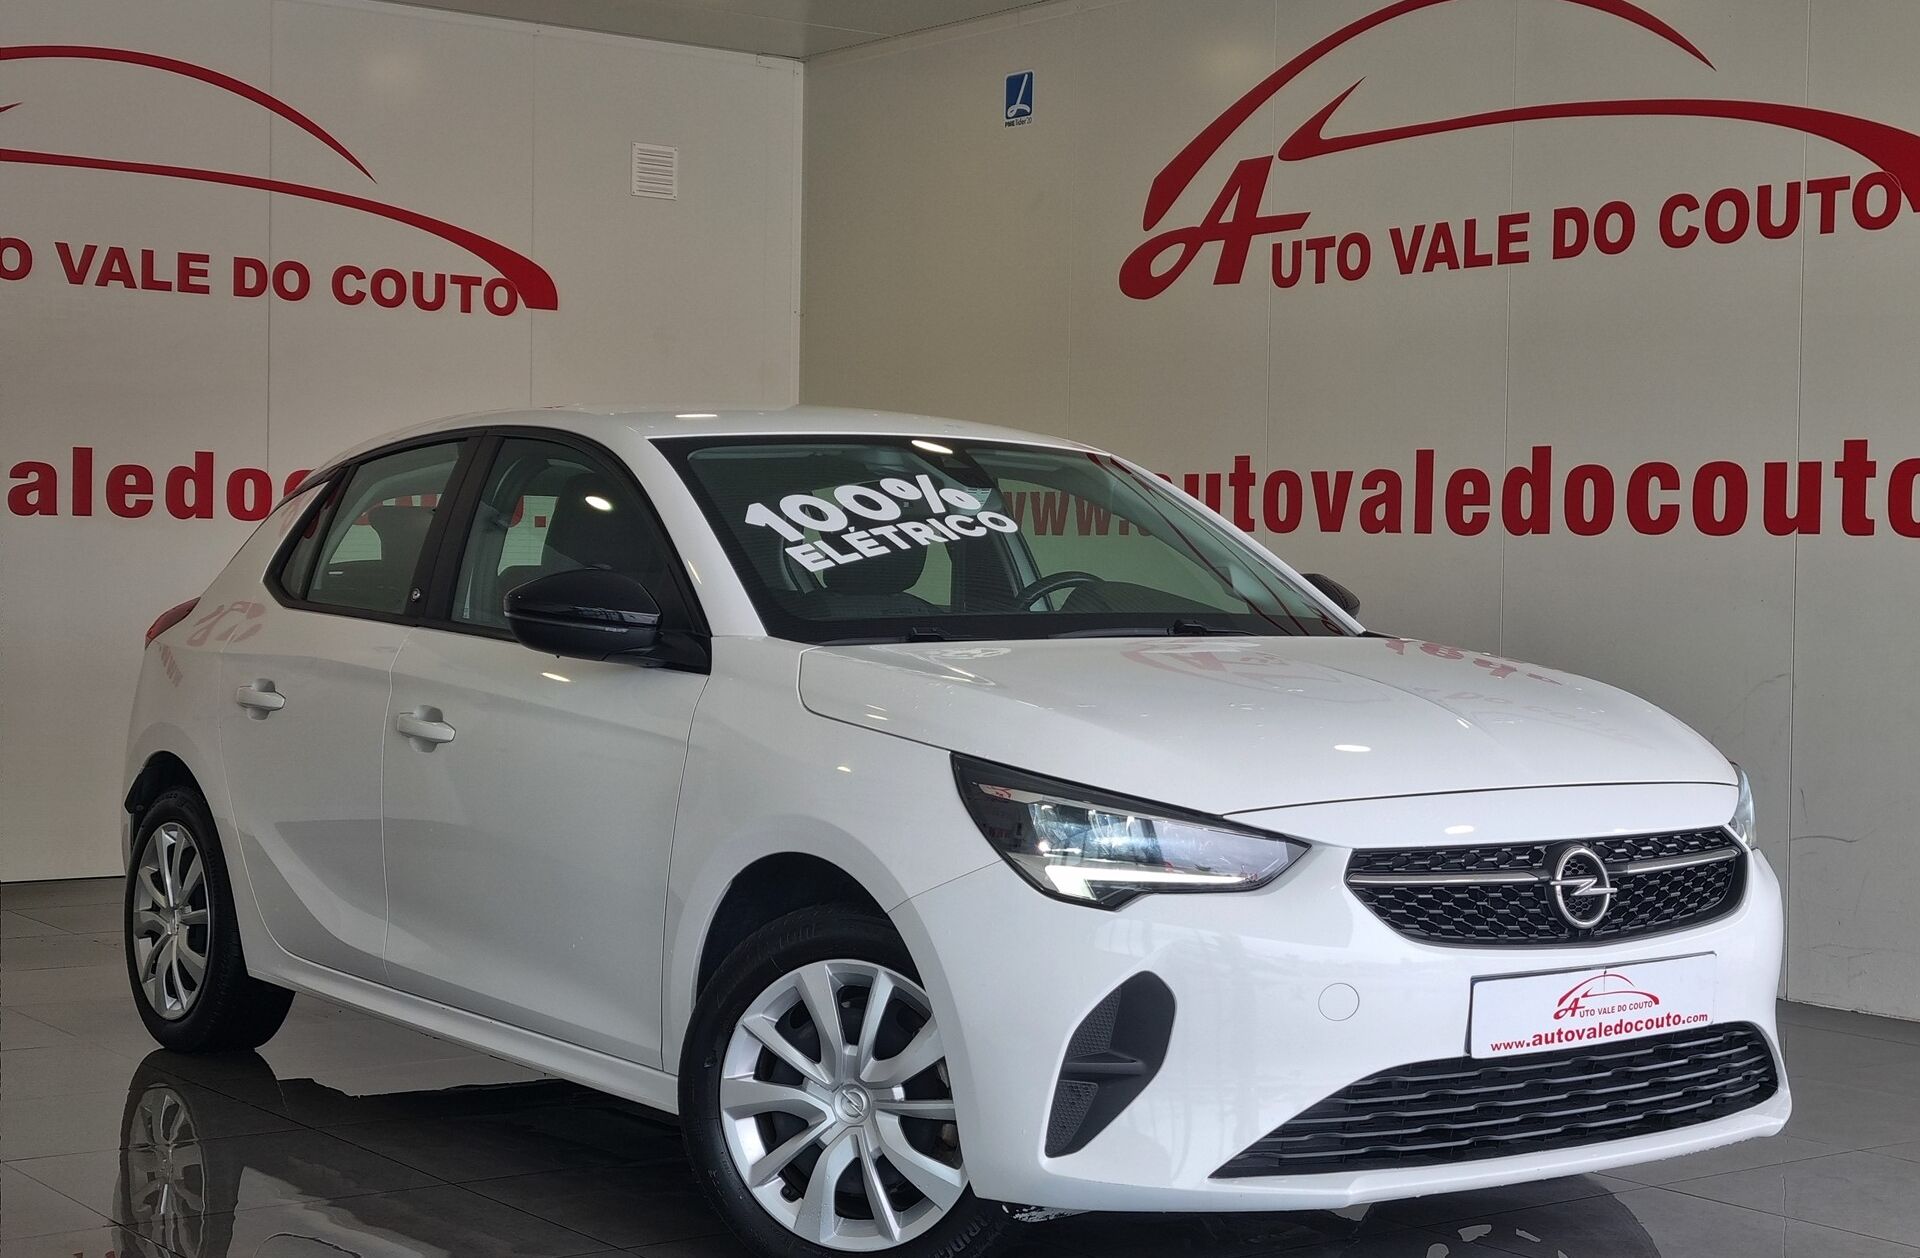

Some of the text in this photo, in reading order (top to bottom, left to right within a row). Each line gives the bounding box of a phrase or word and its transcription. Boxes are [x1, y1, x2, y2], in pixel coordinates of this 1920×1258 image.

[1120, 156, 1902, 300] AUTO VALE DO COUTO
[54, 241, 211, 295] VALE
[232, 256, 312, 302] DO
[331, 264, 519, 317] COUTO
[7, 446, 314, 522] aledo
[744, 474, 982, 543] 100%
[784, 511, 1018, 572] ELÉTRICO
[1490, 1012, 1708, 1051] www.autovaledocouto.com
[1553, 997, 1653, 1019] AUTO VALE DO COUTO
